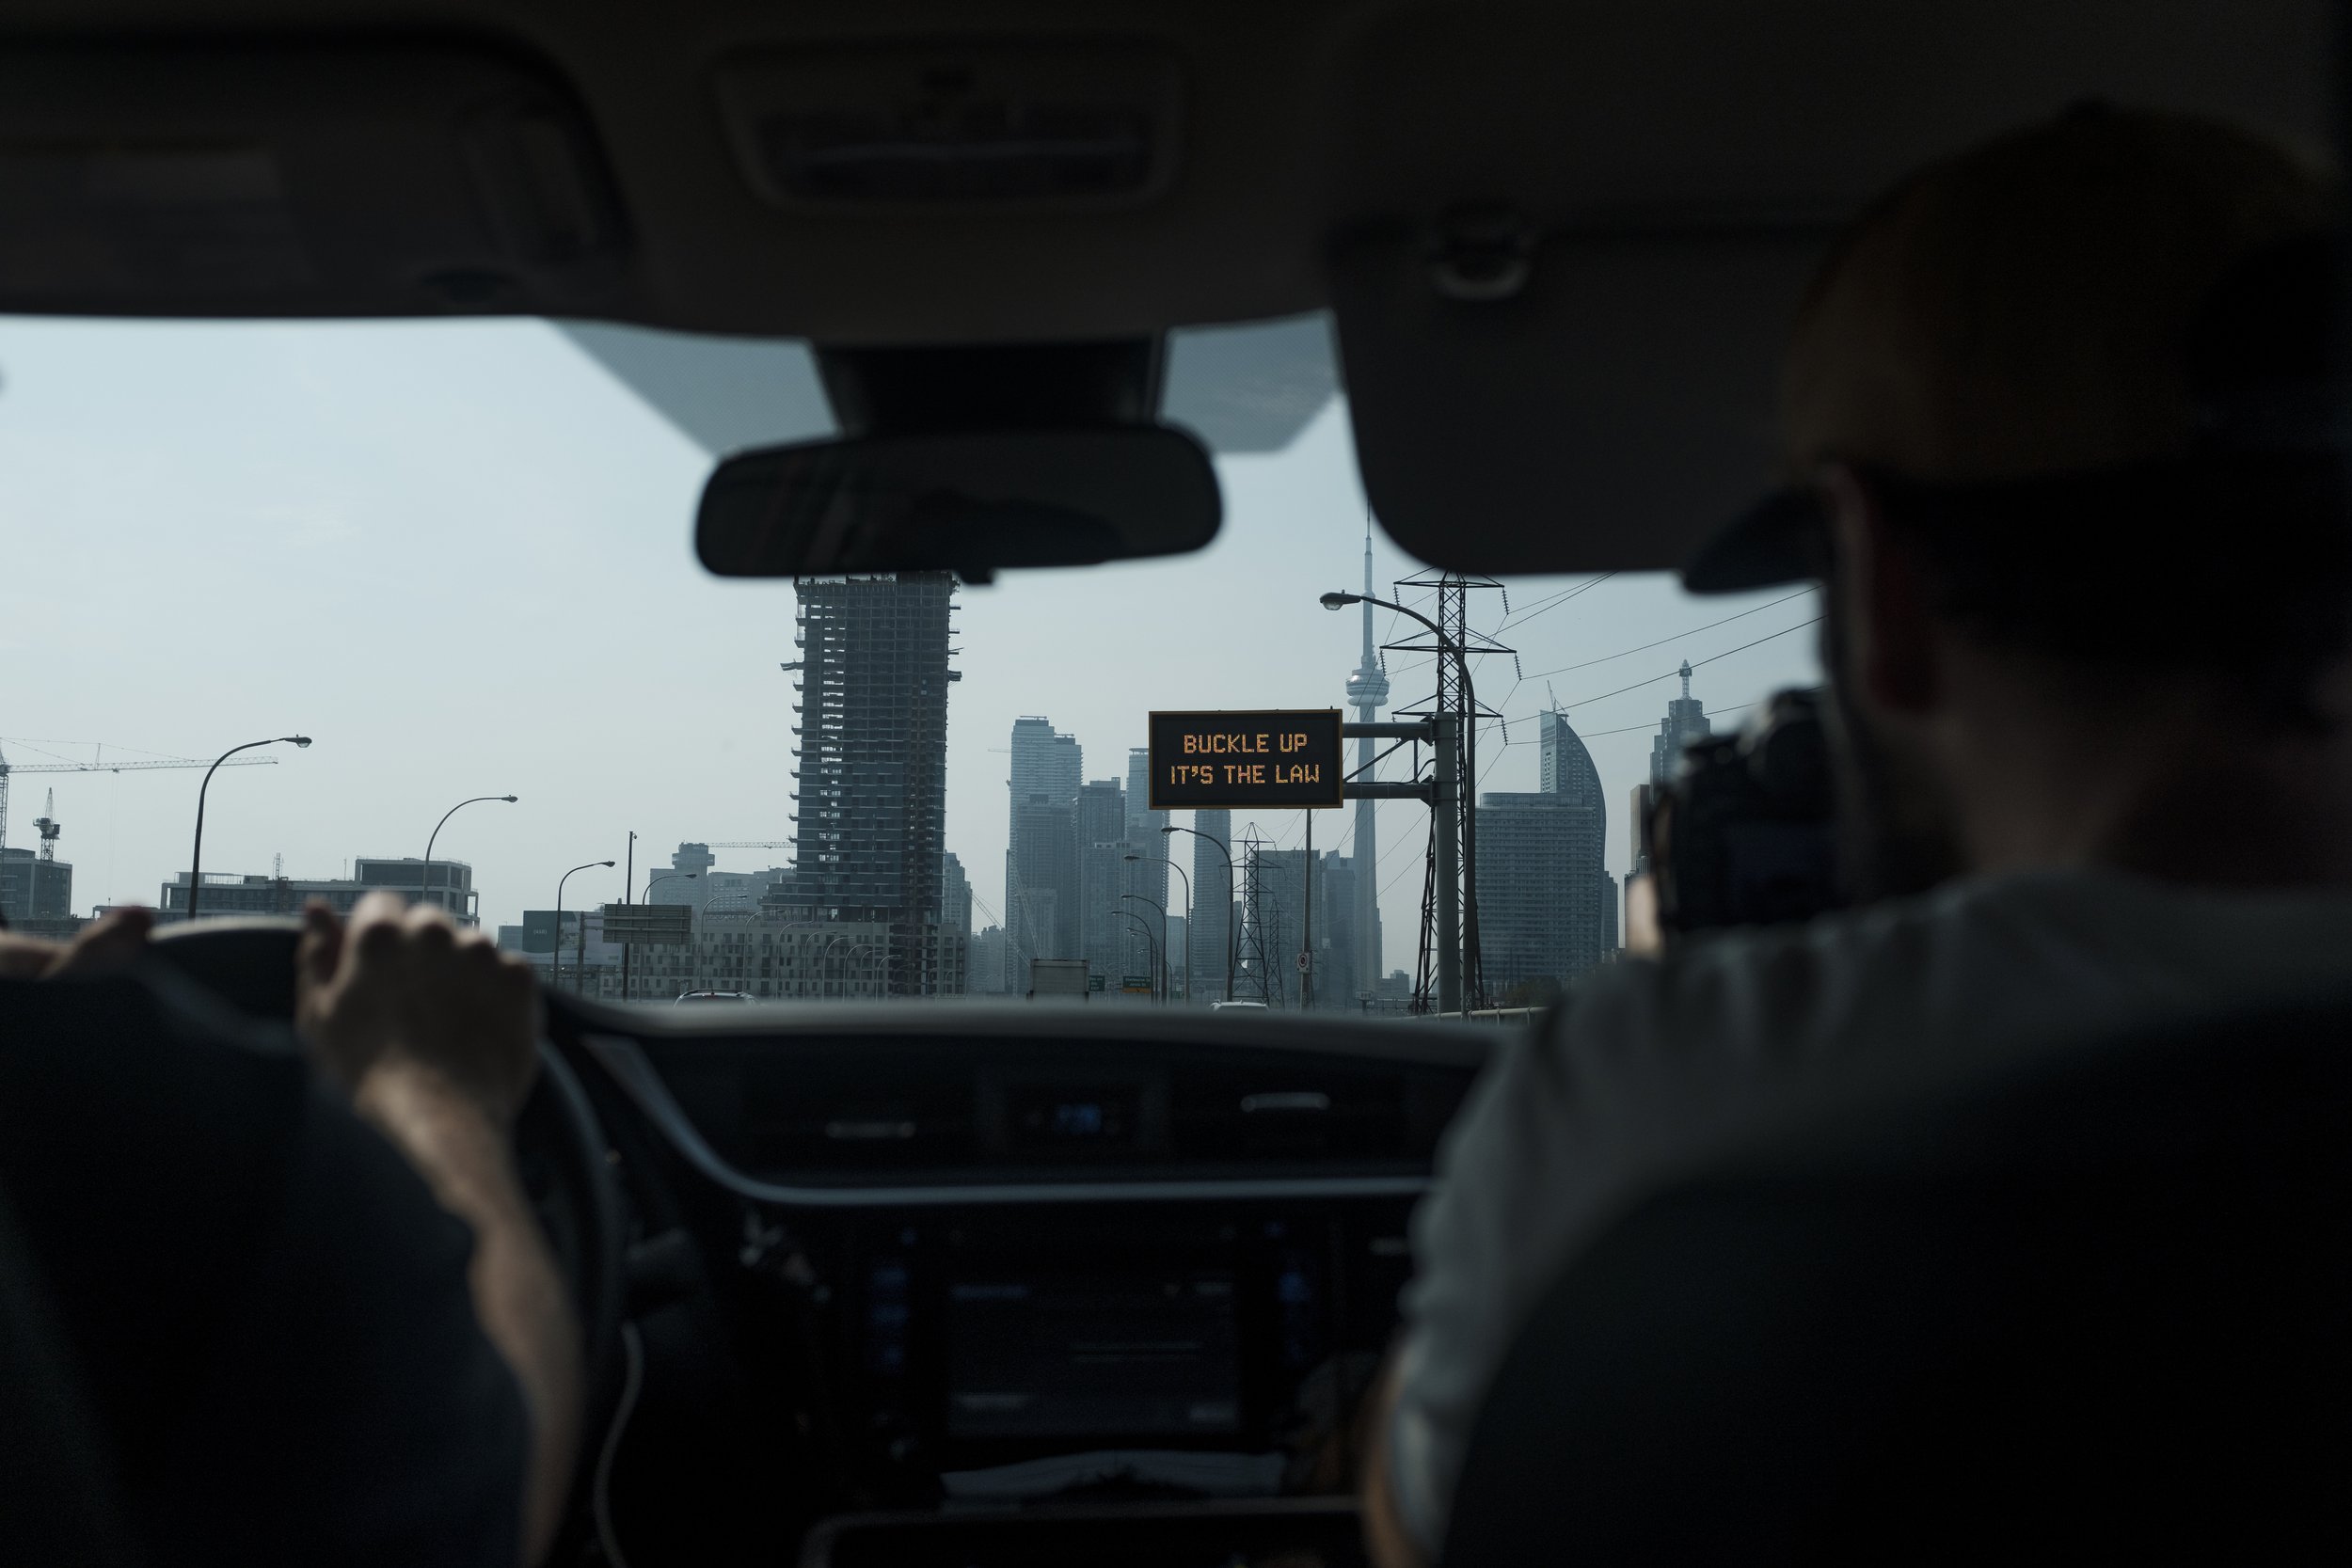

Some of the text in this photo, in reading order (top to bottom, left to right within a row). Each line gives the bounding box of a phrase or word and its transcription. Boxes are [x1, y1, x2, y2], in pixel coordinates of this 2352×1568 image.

[1184, 733, 1308, 753] BUCKLE UP
[1170, 764, 1320, 784] IT'S THE LAW
